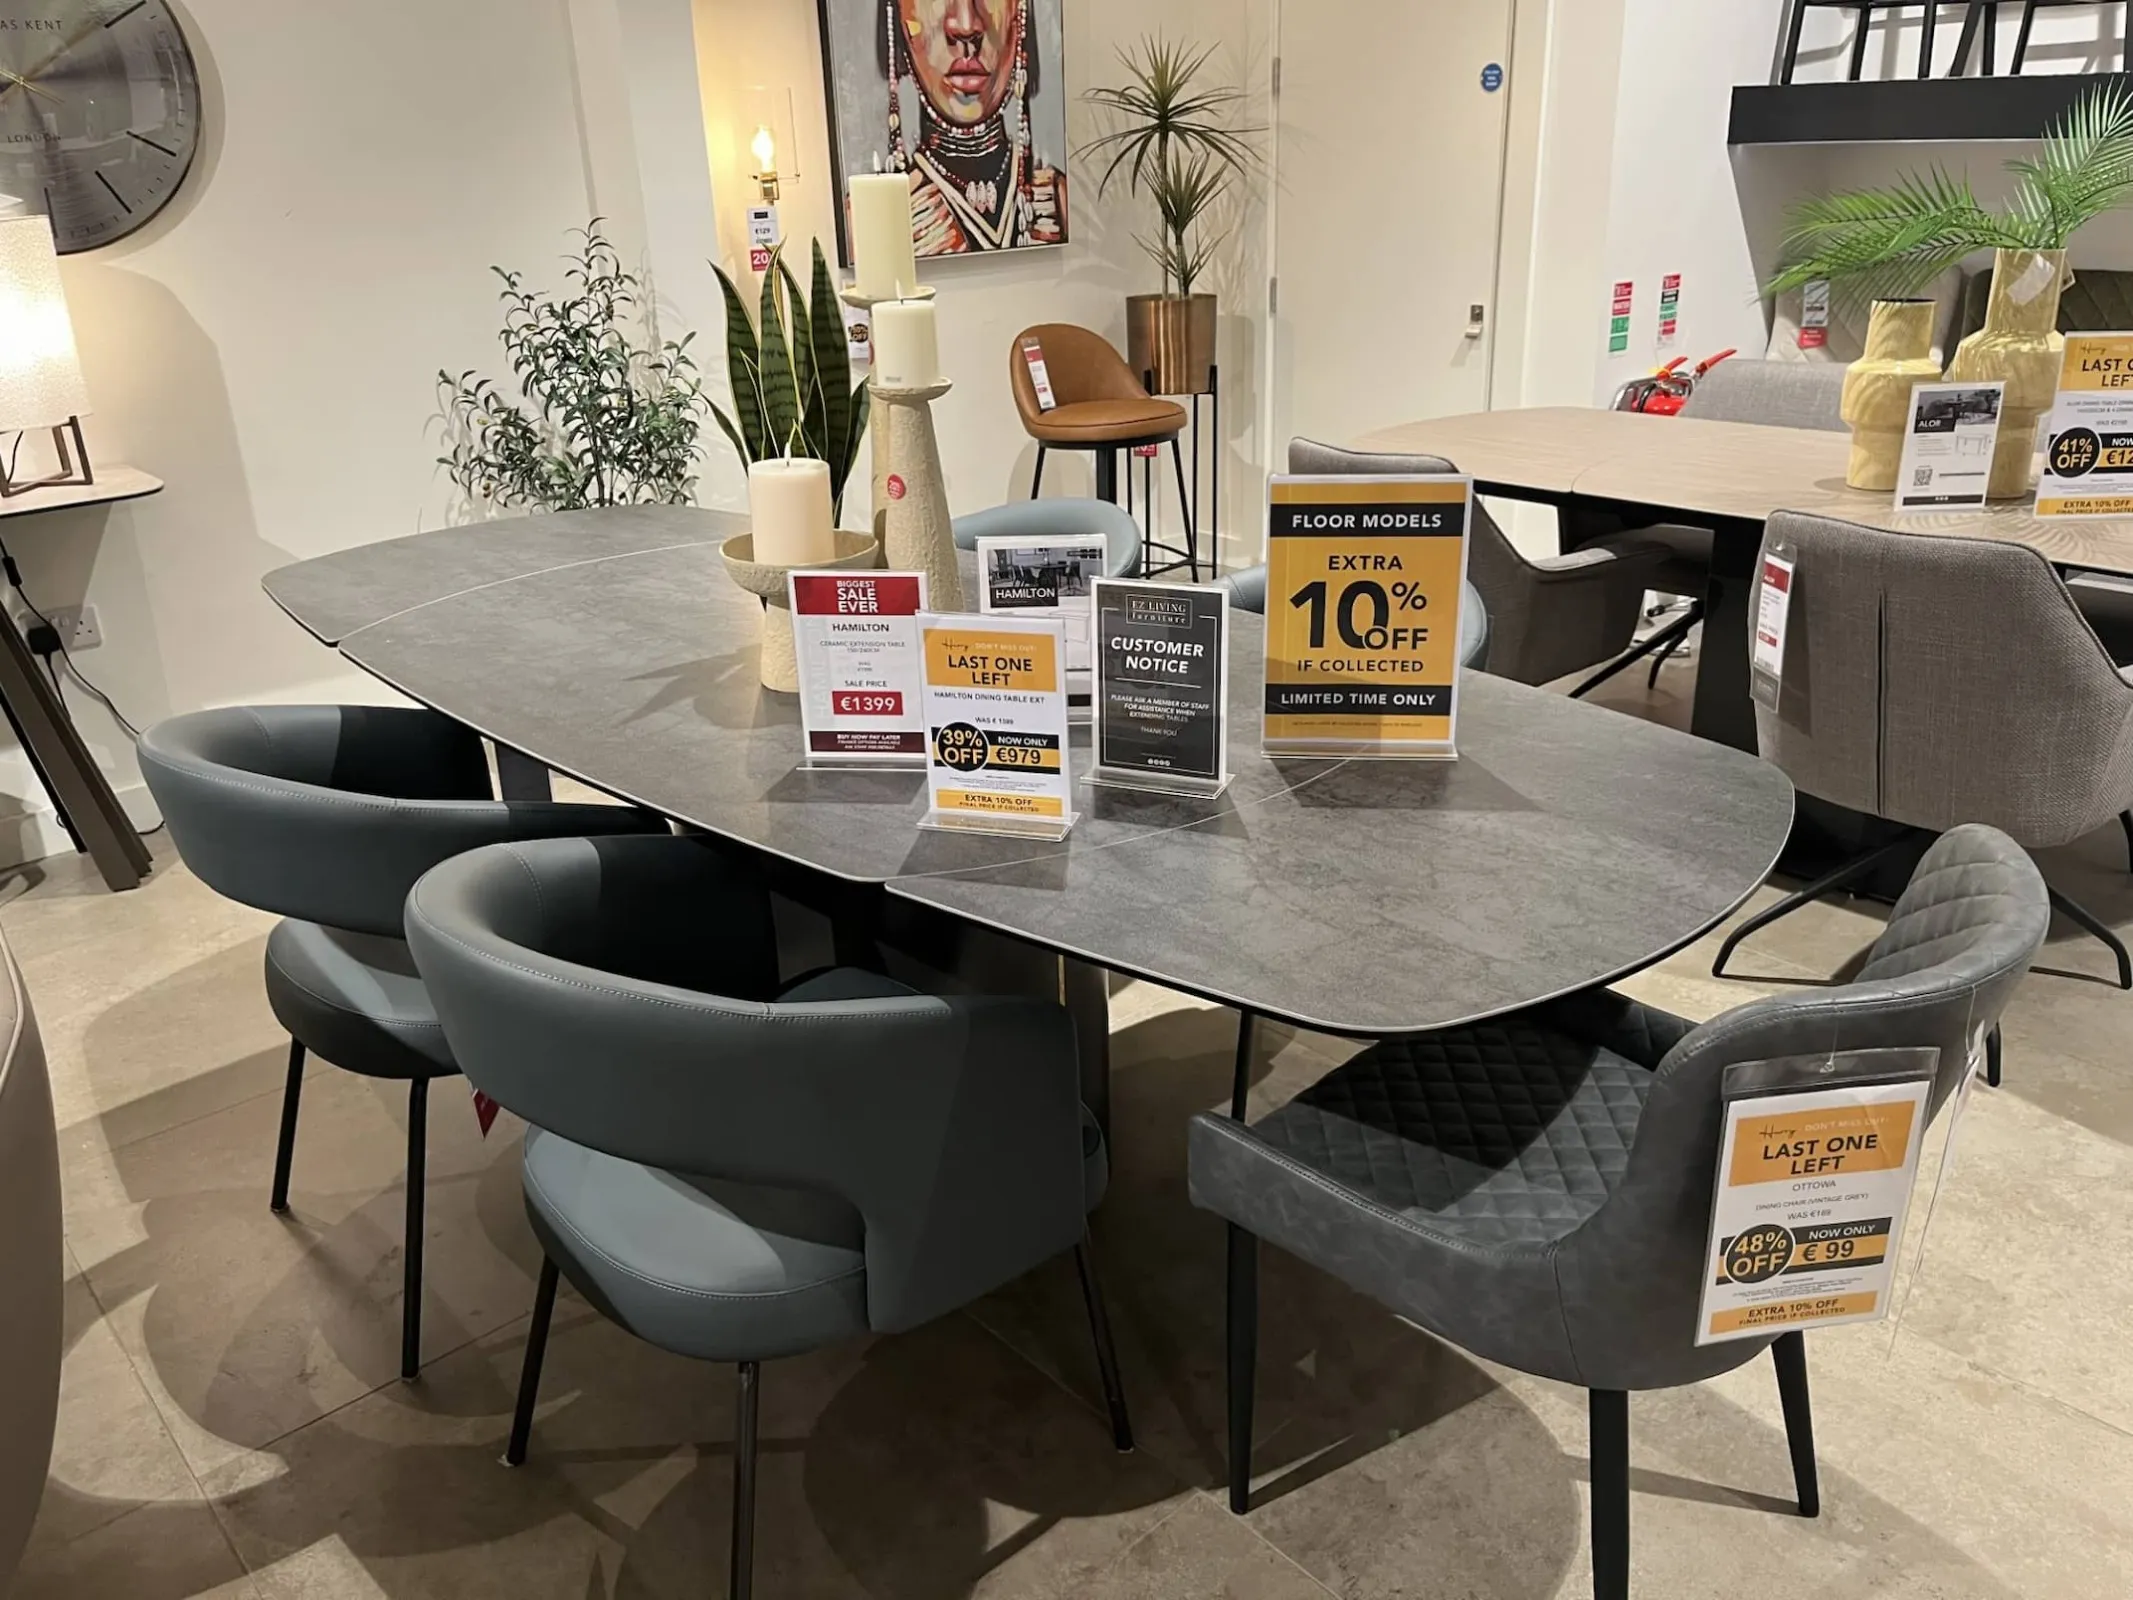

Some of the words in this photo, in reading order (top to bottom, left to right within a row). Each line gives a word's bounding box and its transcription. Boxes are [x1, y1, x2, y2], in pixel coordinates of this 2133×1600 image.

[25, 20, 62, 30] KENT
[2082, 358, 2123, 371] LAST
[2101, 374, 2133, 387] LEF
[2059, 438, 2093, 453] 41%
[2057, 453, 2092, 468] OFF
[2064, 500, 2092, 508] EXTRA
[2114, 499, 2130, 507] OFF
[1292, 514, 1355, 529] FLOOR
[1362, 513, 1442, 528] MODELS
[1328, 555, 1403, 571] EXTRA
[836, 580, 876, 588] BIGGEST
[837, 588, 876, 601] SALE
[995, 588, 1055, 599] HAMILTON
[838, 601, 878, 613] EVER
[1132, 600, 1145, 609] EZ
[1149, 601, 1186, 612] LIVING
[1132, 612, 1186, 624] furniture
[832, 623, 889, 632] HAMILTON
[1363, 627, 1429, 651] OFF
[1111, 637, 1204, 657] CUSTOMER
[948, 654, 988, 669] LAST
[995, 657, 1032, 671] ONE
[1125, 655, 1189, 674] NOTICE
[1297, 660, 1313, 672] IF
[1320, 660, 1424, 672] COLLECTED
[972, 671, 1010, 686] LEFT
[841, 697, 895, 711] €1399
[934, 692, 972, 700] HAMILTON
[975, 693, 1001, 701] DINING
[1003, 695, 1027, 703] TABLE
[1030, 696, 1045, 704] EXT
[1111, 694, 1133, 702] PLEASE
[1153, 698, 1180, 707] MEMBER
[1191, 702, 1210, 710] STAFF
[1281, 693, 1344, 705] LIMITED
[1349, 693, 1387, 705] TIME
[1393, 694, 1436, 706] ONLY
[1129, 711, 1165, 720] EXTENDING
[1138, 704, 1174, 714] ASSISTANCE
[1176, 708, 1196, 716] WHEN
[1141, 726, 1162, 734] THANK
[943, 729, 983, 747] 39%
[998, 736, 1022, 745] NOW
[1024, 738, 1048, 746] ONLY
[944, 747, 984, 764] OFF
[996, 747, 1041, 764] €979
[965, 794, 992, 803] EXTRA
[996, 797, 1013, 805] 10%
[1015, 798, 1032, 806] OFF
[1763, 1140, 1819, 1160] LAST
[1826, 1134, 1878, 1152] ONE
[1791, 1155, 1845, 1174] LEFT
[1792, 1180, 1836, 1191] OTTOWA
[1756, 1202, 1781, 1210] DINING
[1783, 1199, 1806, 1208] CHAIR
[1844, 1193, 1869, 1201] GREY)
[1787, 1211, 1807, 1220] WAS
[1808, 1228, 1841, 1240] NOW
[1843, 1225, 1876, 1236] ONLY
[1734, 1230, 1787, 1255] 48%
[1803, 1244, 1818, 1262] €
[1825, 1240, 1854, 1259] 99
[1732, 1252, 1786, 1276] OFF
[1749, 1306, 1784, 1318] EXTRA
[1790, 1303, 1812, 1313] 10%
[1816, 1298, 1839, 1309] OFF
[1739, 1317, 1761, 1326] FINAL
[1765, 1314, 1787, 1322] PRICE
[1800, 1307, 1846, 1317] COLLECTED
